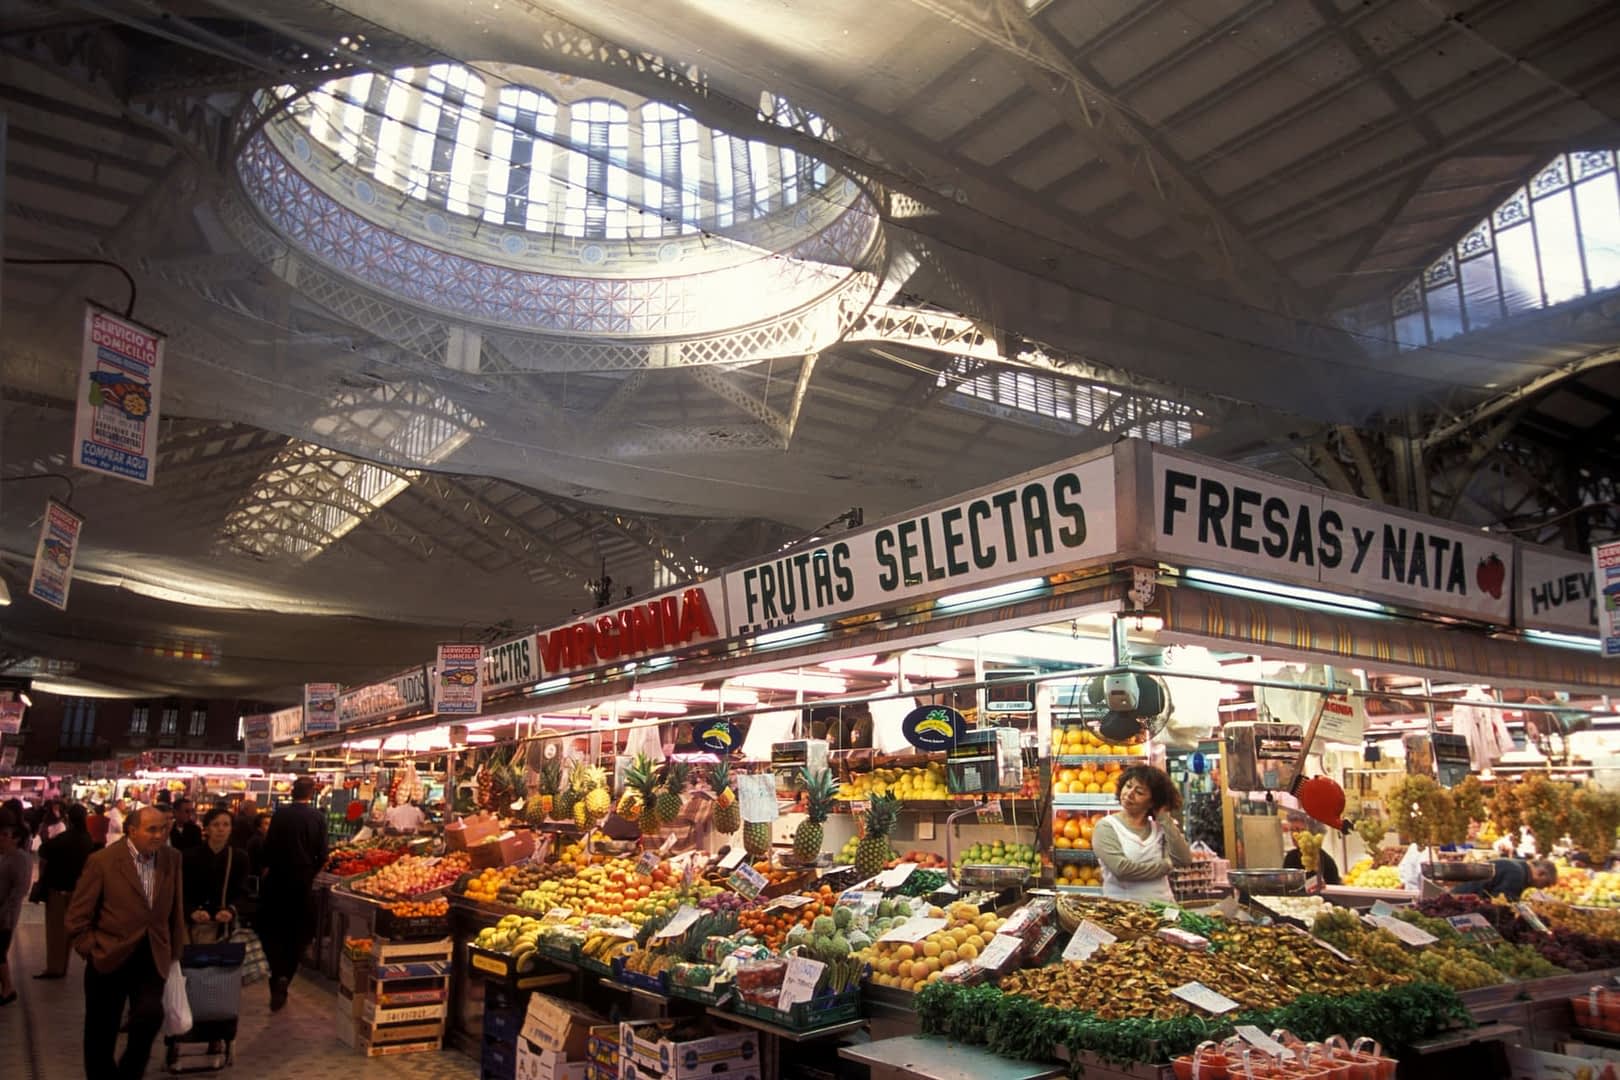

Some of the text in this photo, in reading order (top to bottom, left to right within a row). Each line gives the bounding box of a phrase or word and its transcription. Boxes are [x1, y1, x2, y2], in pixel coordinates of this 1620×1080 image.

[93, 330, 155, 364] DOMICILIO
[94, 316, 155, 353] SERVICIO A
[83, 442, 125, 464] COMPRAR
[744, 472, 1087, 623] FRUTAS SELECTAS
[1163, 469, 1343, 568] FRESAS
[1382, 523, 1467, 595] NATA
[1531, 571, 1596, 615] HUEV
[537, 587, 719, 674] VIRGINIA
[158, 751, 240, 766] FRUTAS
